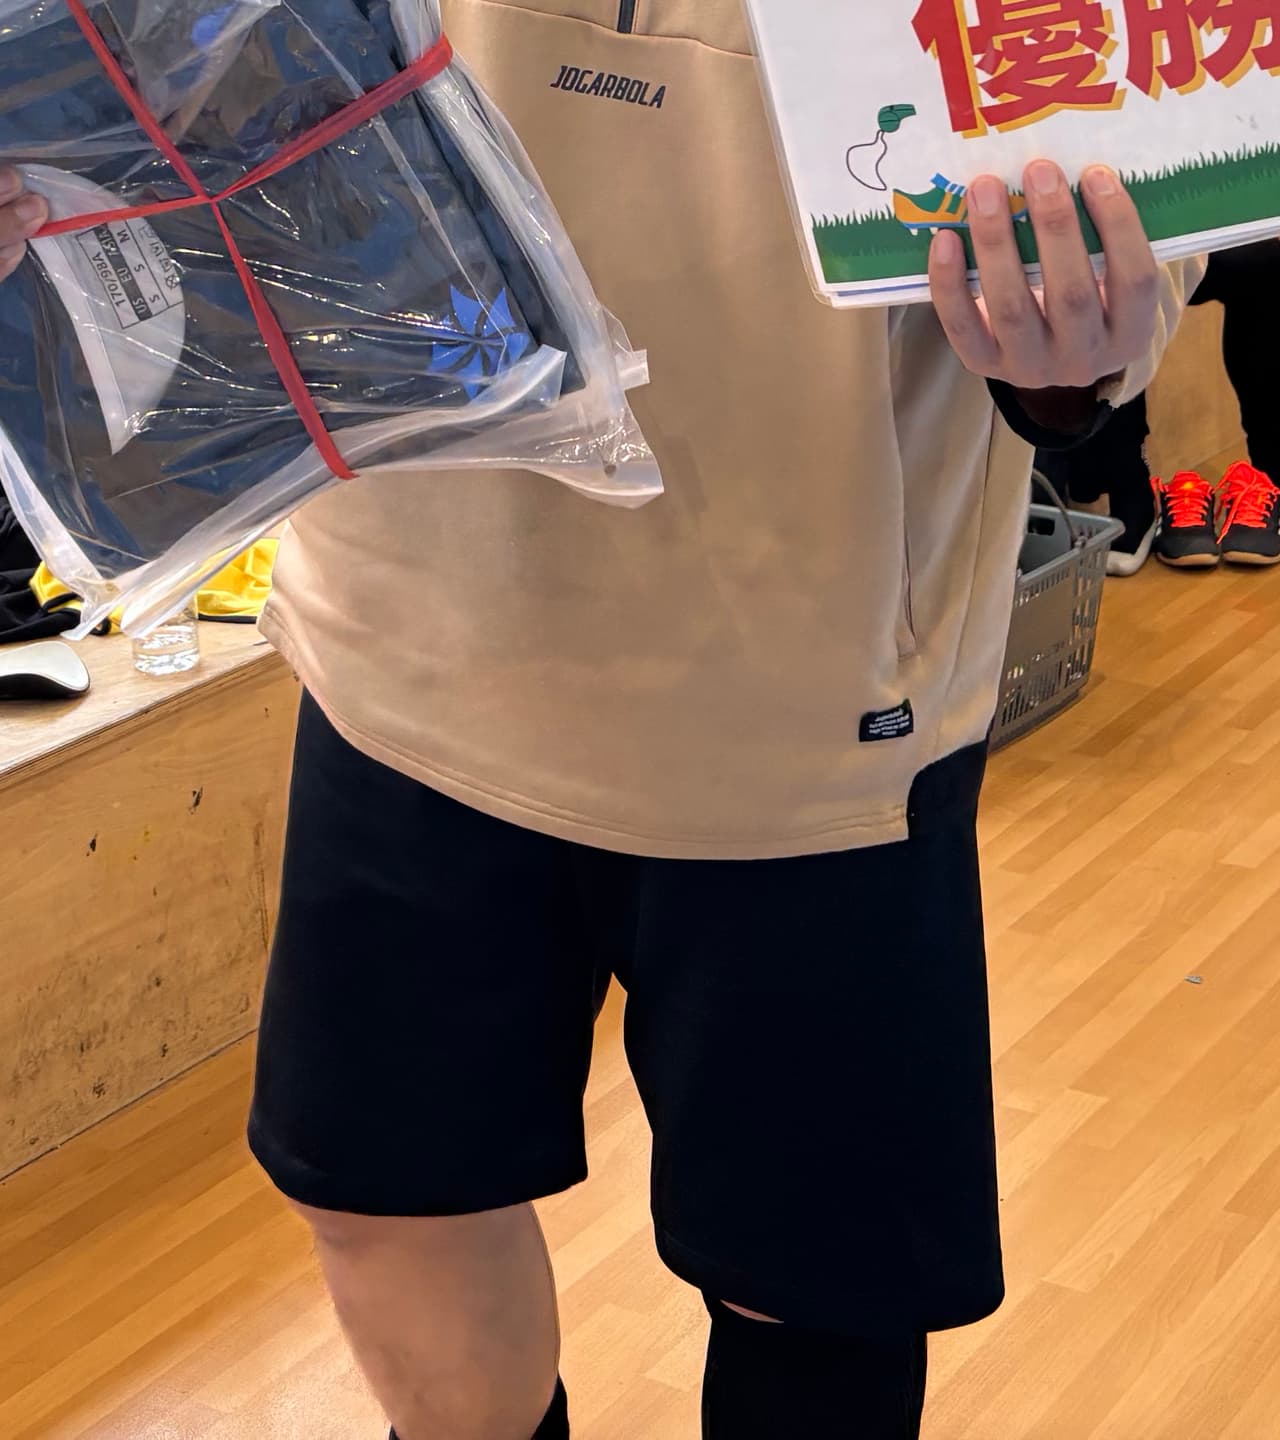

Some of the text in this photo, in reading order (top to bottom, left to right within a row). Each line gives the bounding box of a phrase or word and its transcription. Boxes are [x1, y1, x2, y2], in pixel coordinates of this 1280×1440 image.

[550, 65, 667, 109] JOGARBOLA
[91, 251, 127, 308] 170/98A
[116, 228, 161, 304] S S M
[116, 266, 133, 283] EU
[131, 297, 148, 314] US
